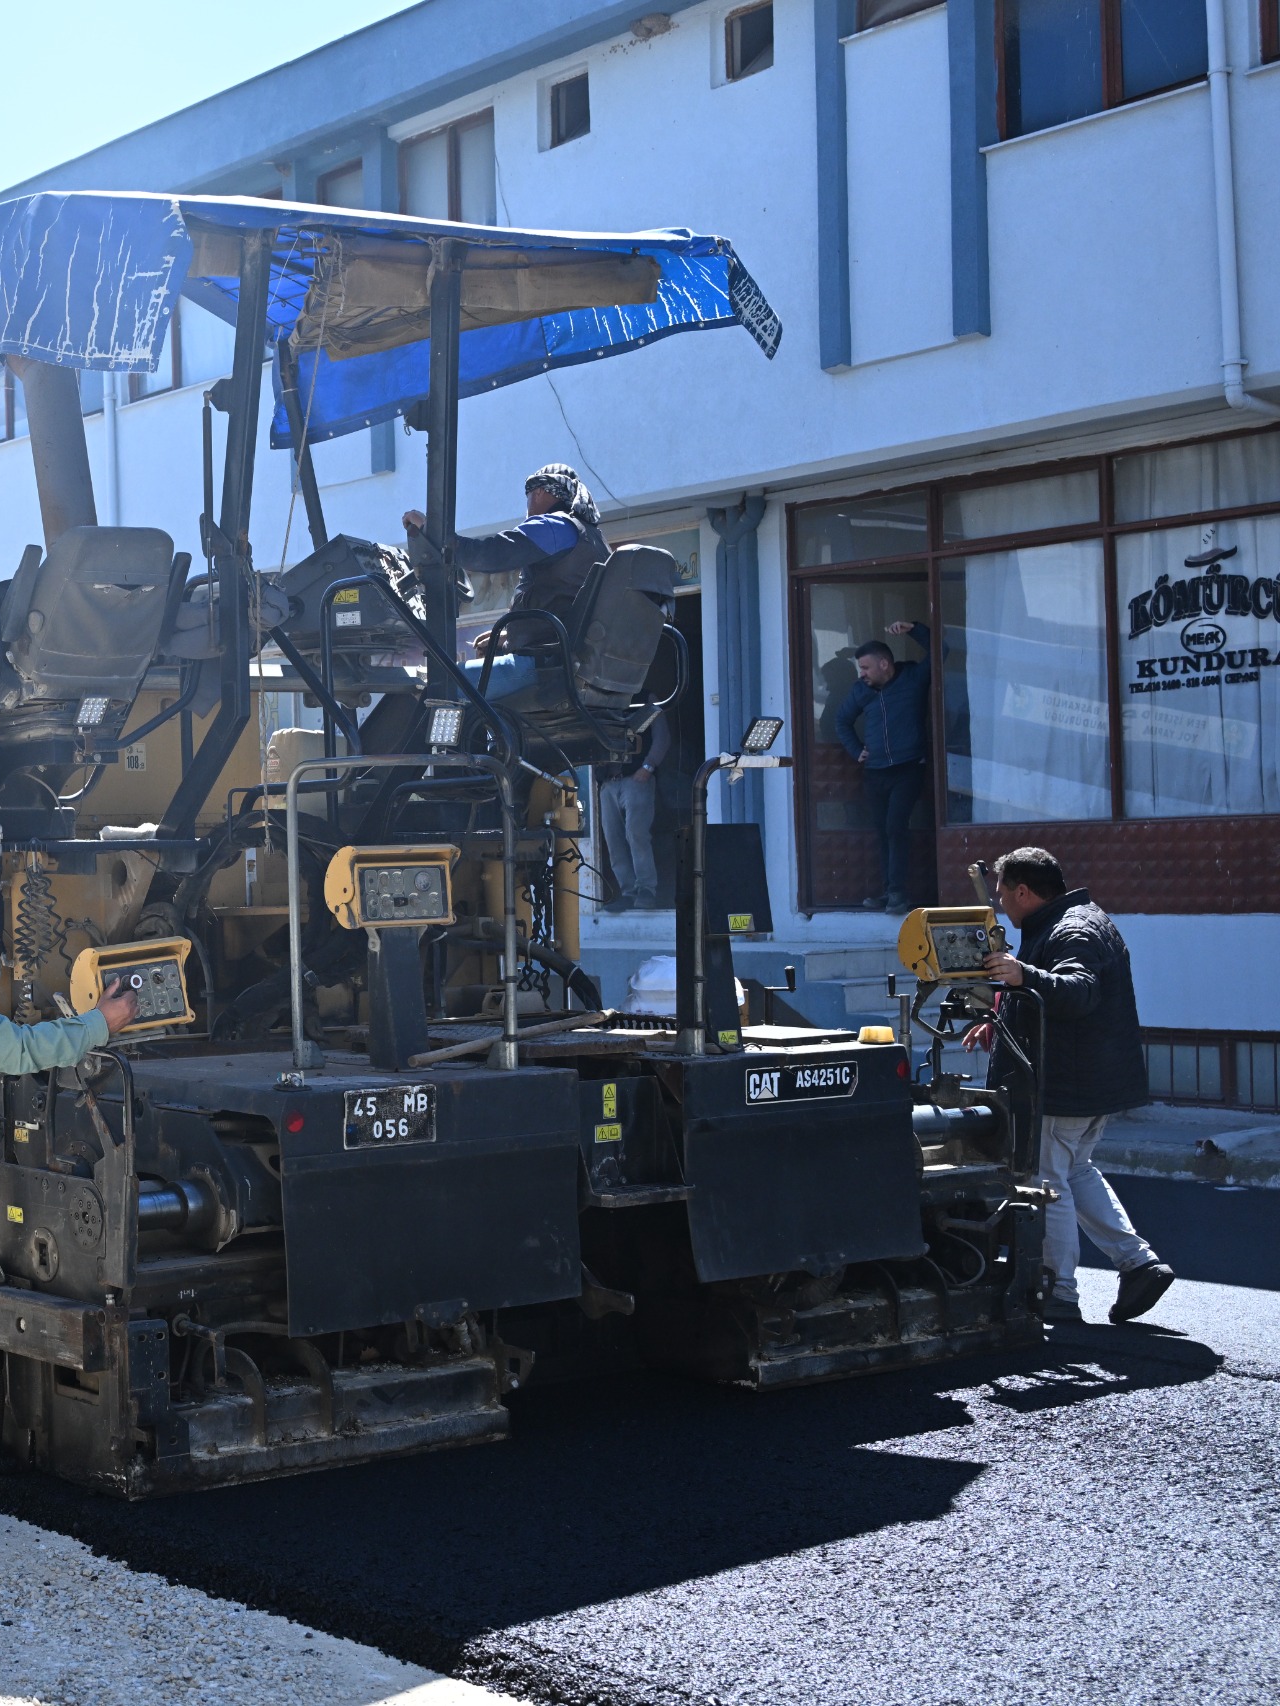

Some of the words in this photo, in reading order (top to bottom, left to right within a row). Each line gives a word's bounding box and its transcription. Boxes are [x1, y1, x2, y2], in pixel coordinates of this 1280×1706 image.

[126, 755, 139, 769] 108
[749, 1072, 781, 1100] CAT
[795, 1066, 850, 1088] AS4251C
[354, 1096, 377, 1117] 45
[403, 1093, 428, 1113] MB
[373, 1118, 409, 1139] 056
